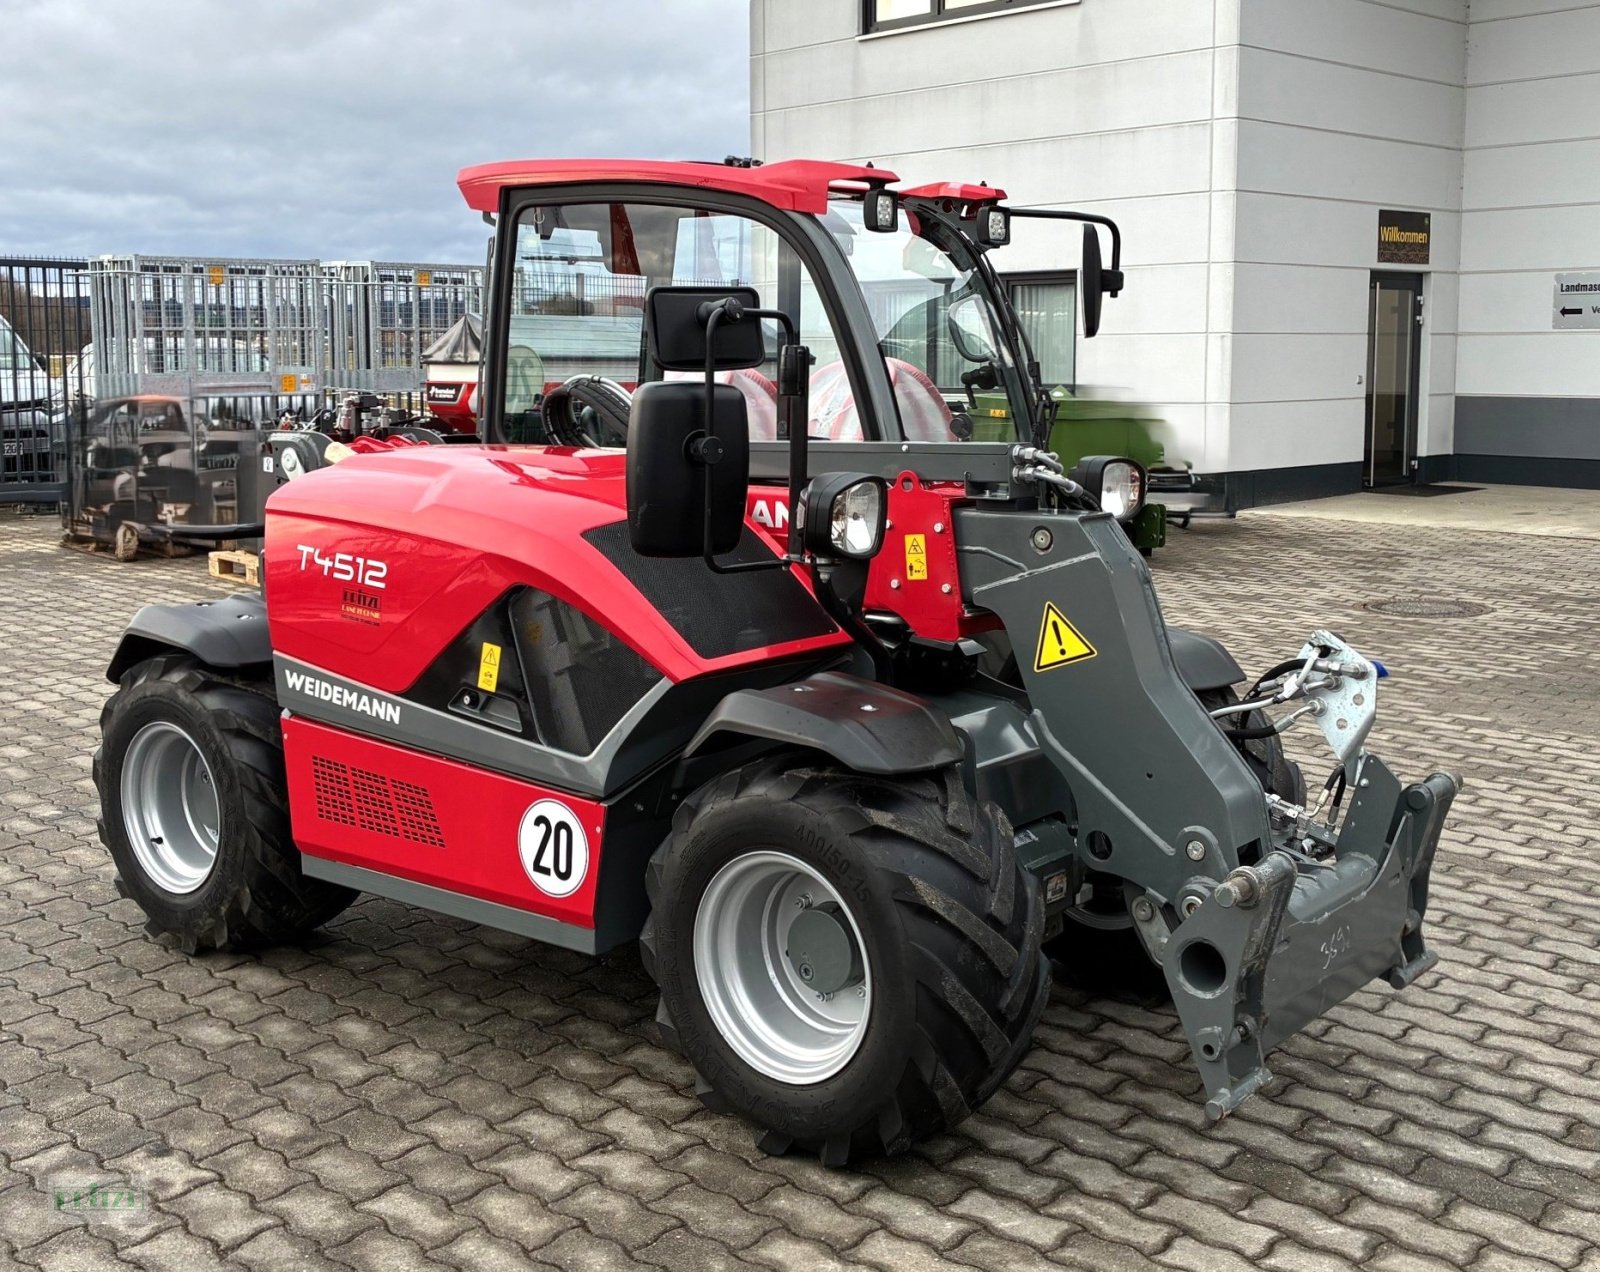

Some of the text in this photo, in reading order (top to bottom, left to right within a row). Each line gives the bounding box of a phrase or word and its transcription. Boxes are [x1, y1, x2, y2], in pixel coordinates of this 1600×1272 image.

[1380, 226, 1428, 244] Willkommen
[296, 544, 388, 589] T4512
[284, 669, 401, 726] WEIDEMANN
[532, 814, 573, 881] 20
